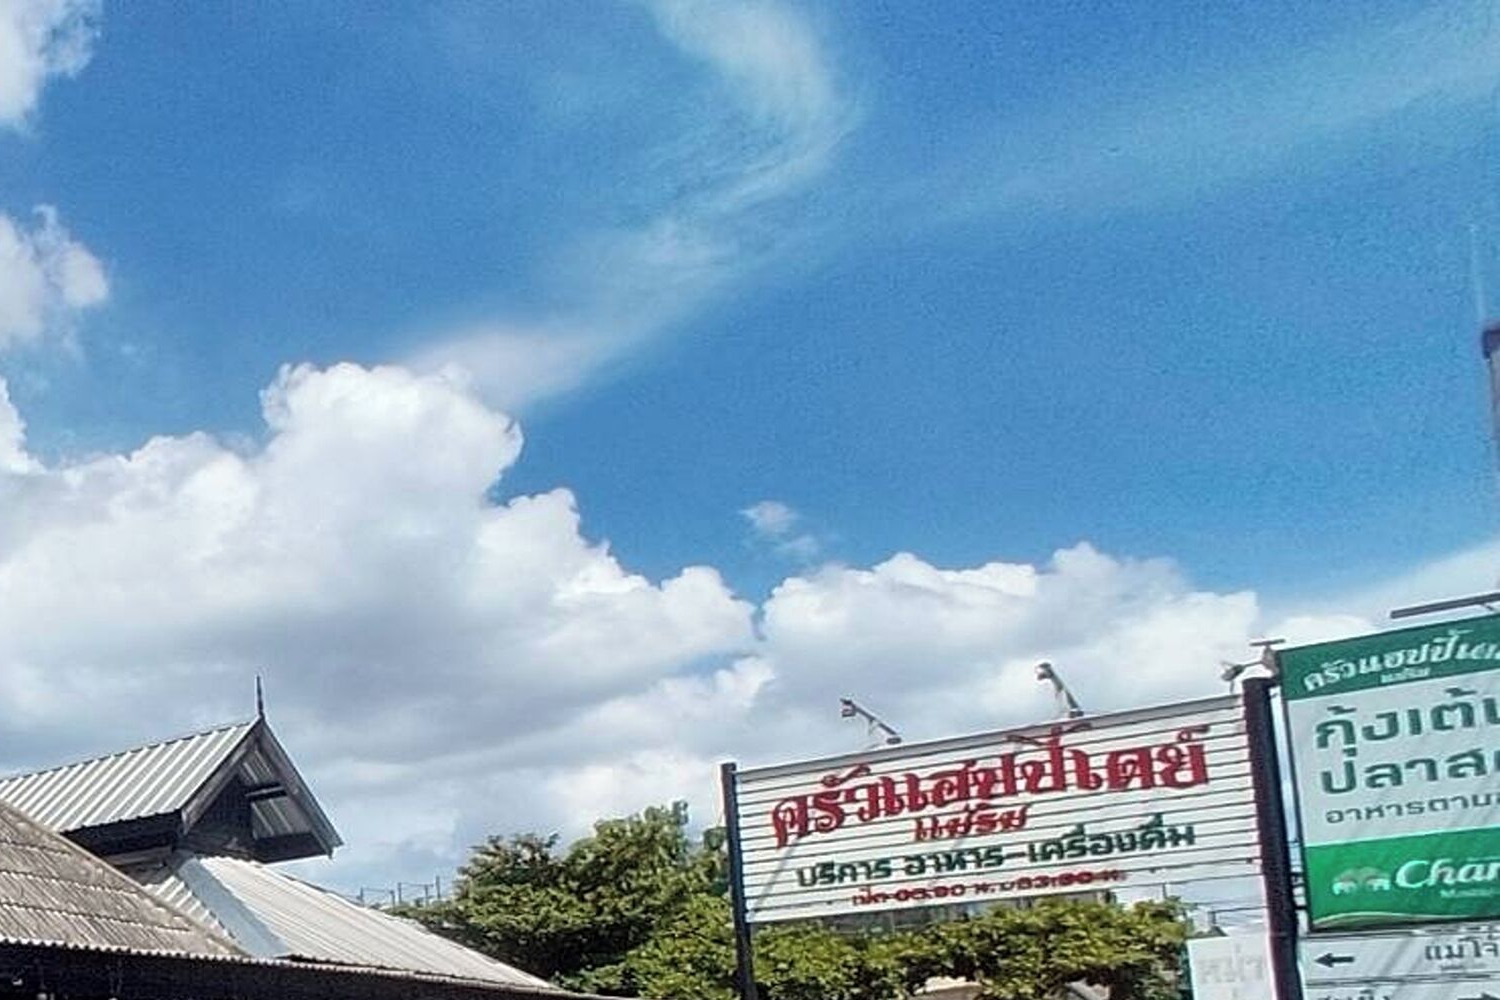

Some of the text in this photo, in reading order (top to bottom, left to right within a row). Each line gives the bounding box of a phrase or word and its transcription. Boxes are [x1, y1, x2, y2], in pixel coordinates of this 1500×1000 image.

[1304, 629, 1500, 690] ครัวแฮปปี้เด
[773, 721, 1210, 848] ครัวแฮปปี้เดย์
[1321, 749, 1500, 794] ปลาส
[1326, 794, 1500, 823] อาหารตาม
[796, 851, 892, 888] บริการ
